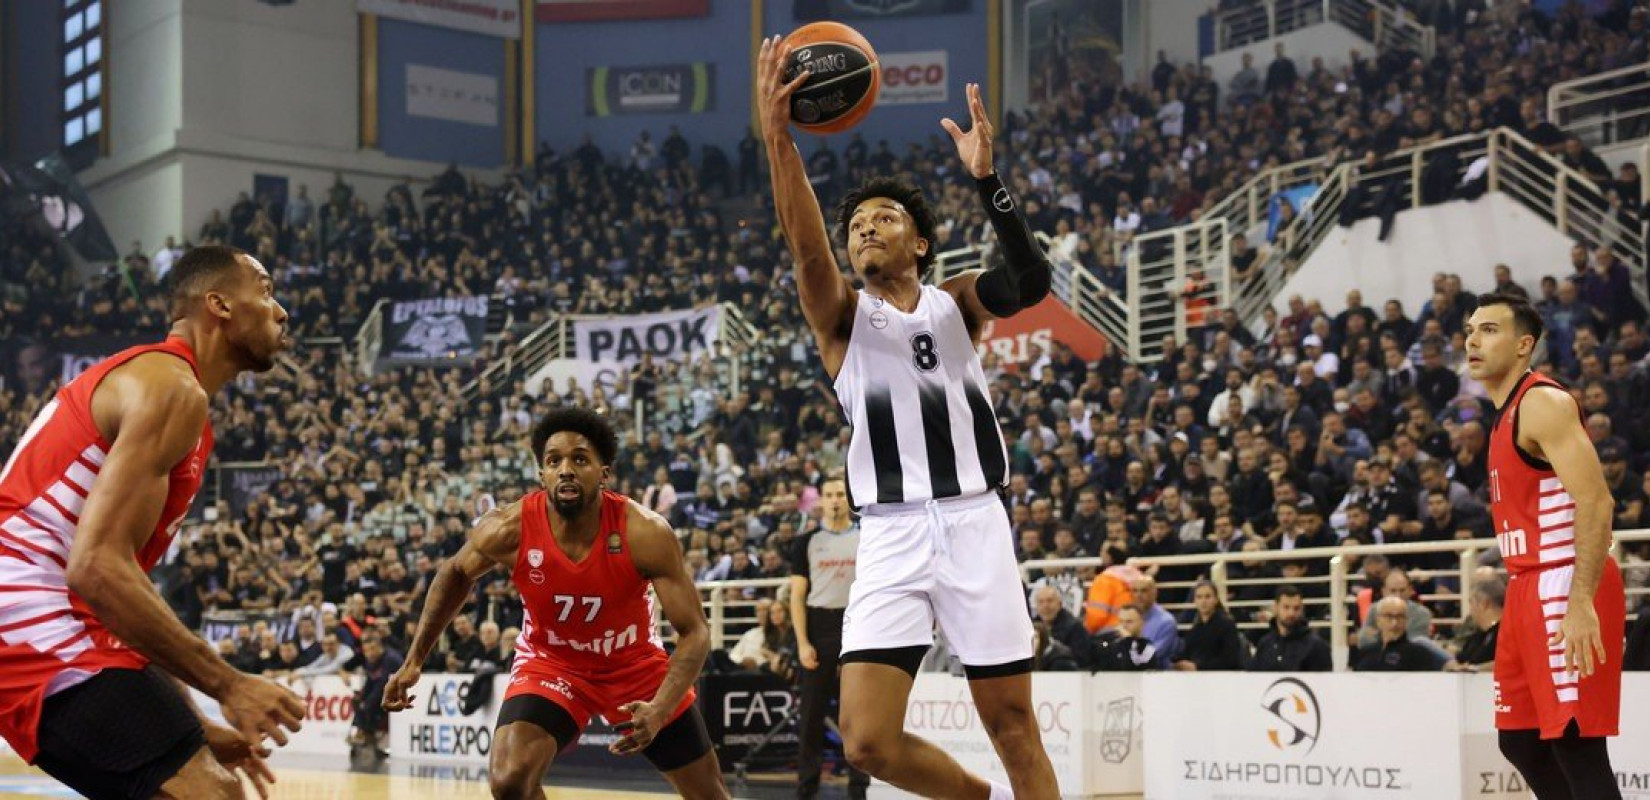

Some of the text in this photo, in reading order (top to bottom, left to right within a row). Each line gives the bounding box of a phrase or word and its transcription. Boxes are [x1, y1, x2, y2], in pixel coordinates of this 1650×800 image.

[619, 72, 680, 94] ICON
[881, 63, 943, 87] eco
[589, 315, 707, 363] PAOK
[914, 333, 940, 372] 8
[554, 595, 602, 622] 77
[723, 691, 797, 727] FAR
[410, 725, 492, 755] HELEXPO
[1184, 760, 1401, 790] ΣΙΔΗΡΟΠΟΥΛΟΣ
